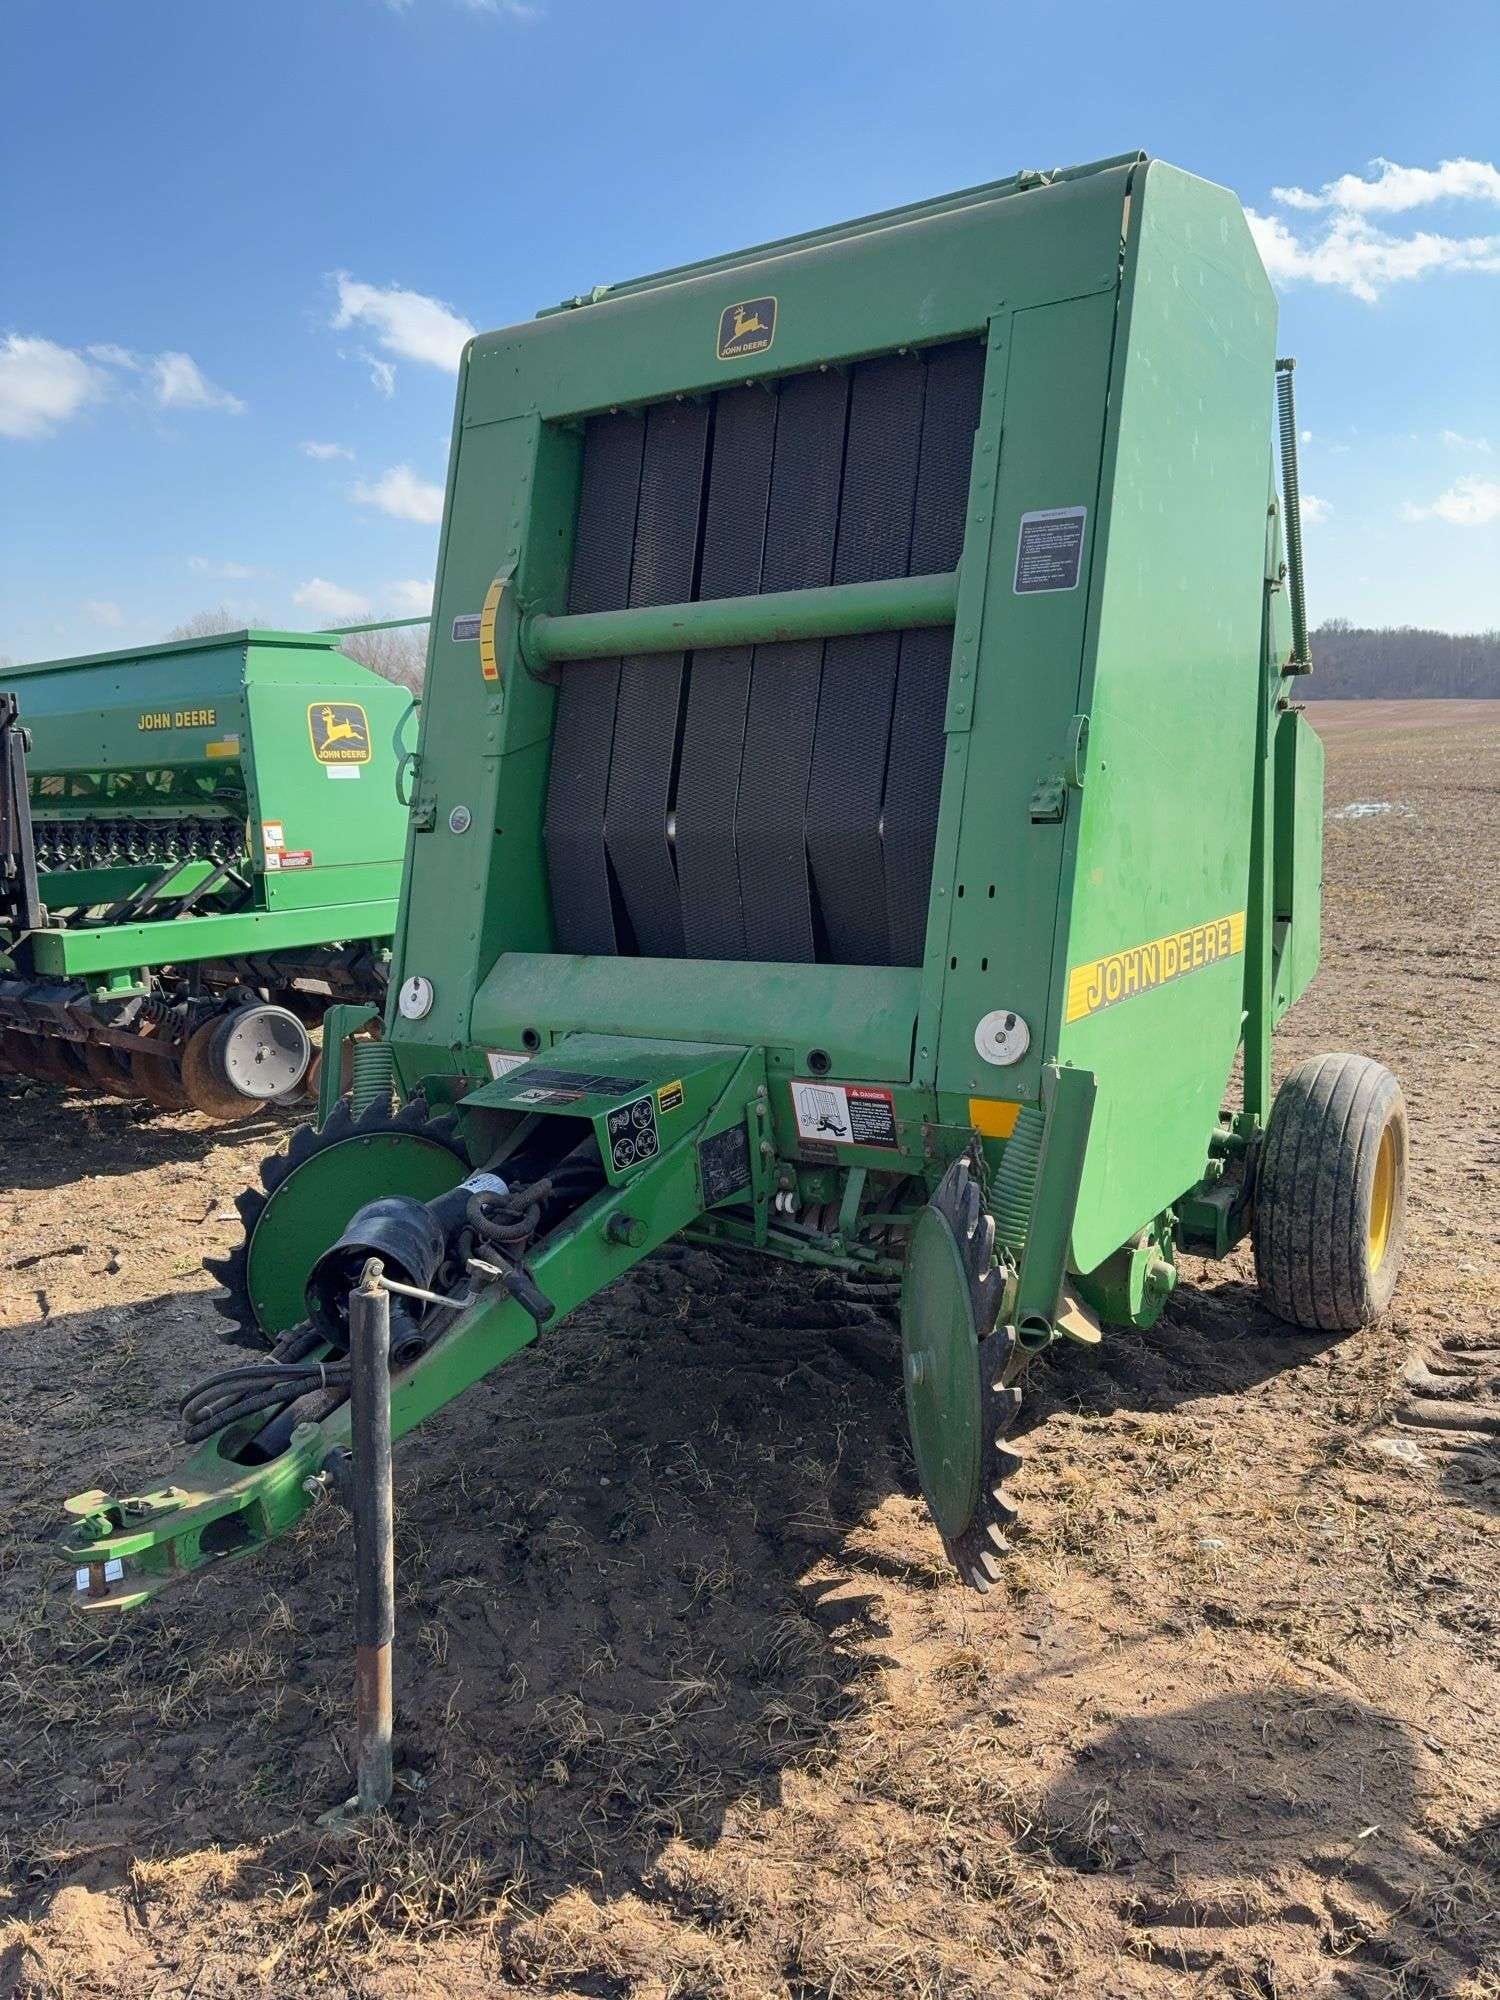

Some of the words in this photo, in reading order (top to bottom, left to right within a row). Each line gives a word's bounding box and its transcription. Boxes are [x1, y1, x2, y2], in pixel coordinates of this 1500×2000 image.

[721, 345, 742, 356] JOHN
[743, 340, 768, 350] DEERE
[138, 712, 171, 730] JOHN
[175, 709, 215, 728] DEERE
[318, 750, 341, 758] JOHN
[341, 750, 367, 758] DEERE
[1087, 944, 1159, 1010] JOHN
[1164, 920, 1231, 978] DEERE
